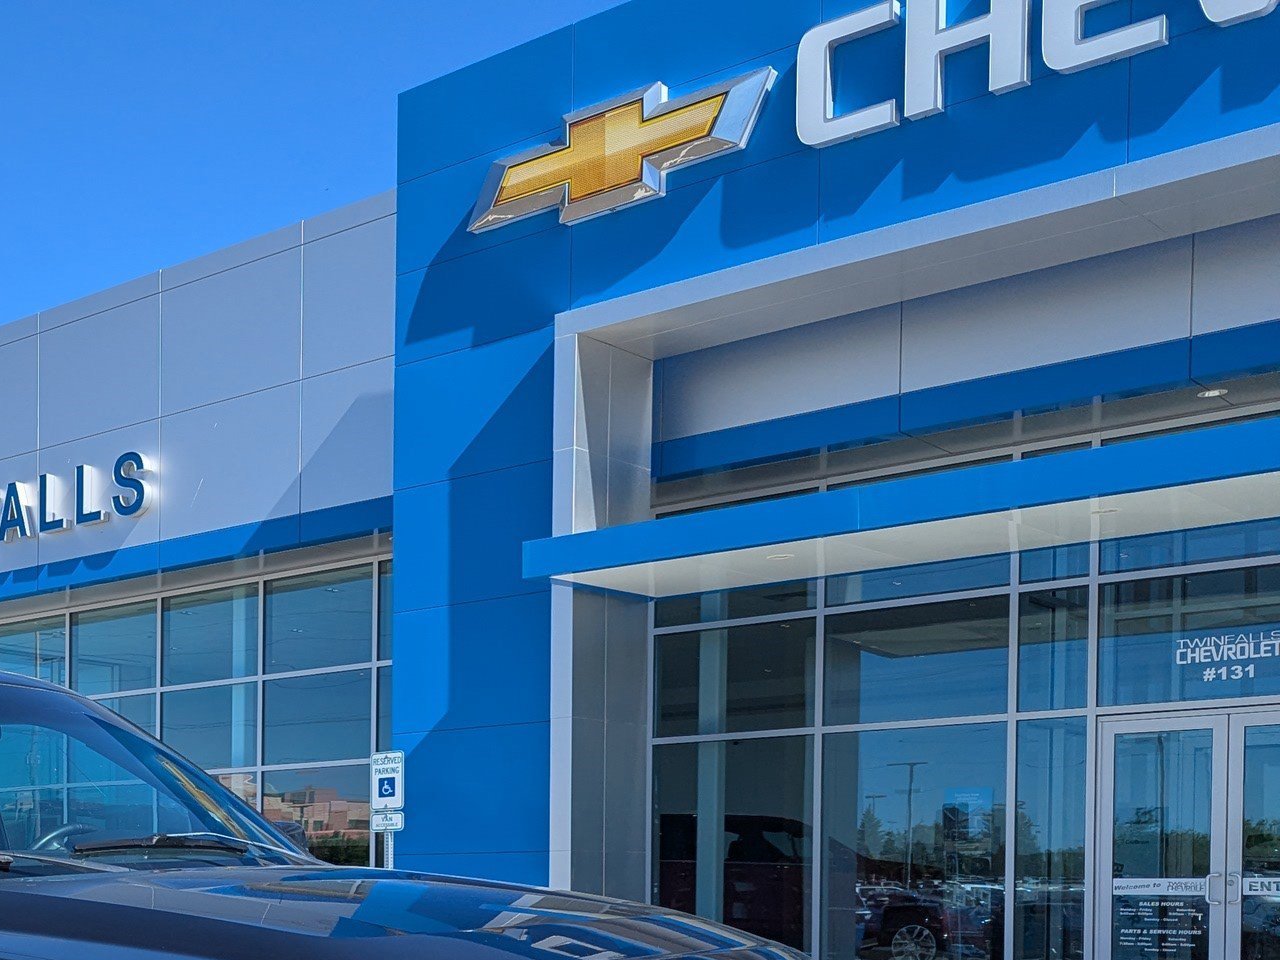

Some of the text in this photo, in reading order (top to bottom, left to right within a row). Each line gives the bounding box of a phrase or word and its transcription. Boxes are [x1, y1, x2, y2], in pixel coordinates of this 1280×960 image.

[796, 0, 1280, 148] CHE
[1203, 664, 1255, 682] #131
[373, 756, 402, 766] RESERVED
[374, 766, 400, 775] PARKING
[1114, 883, 1151, 891] Welcome
